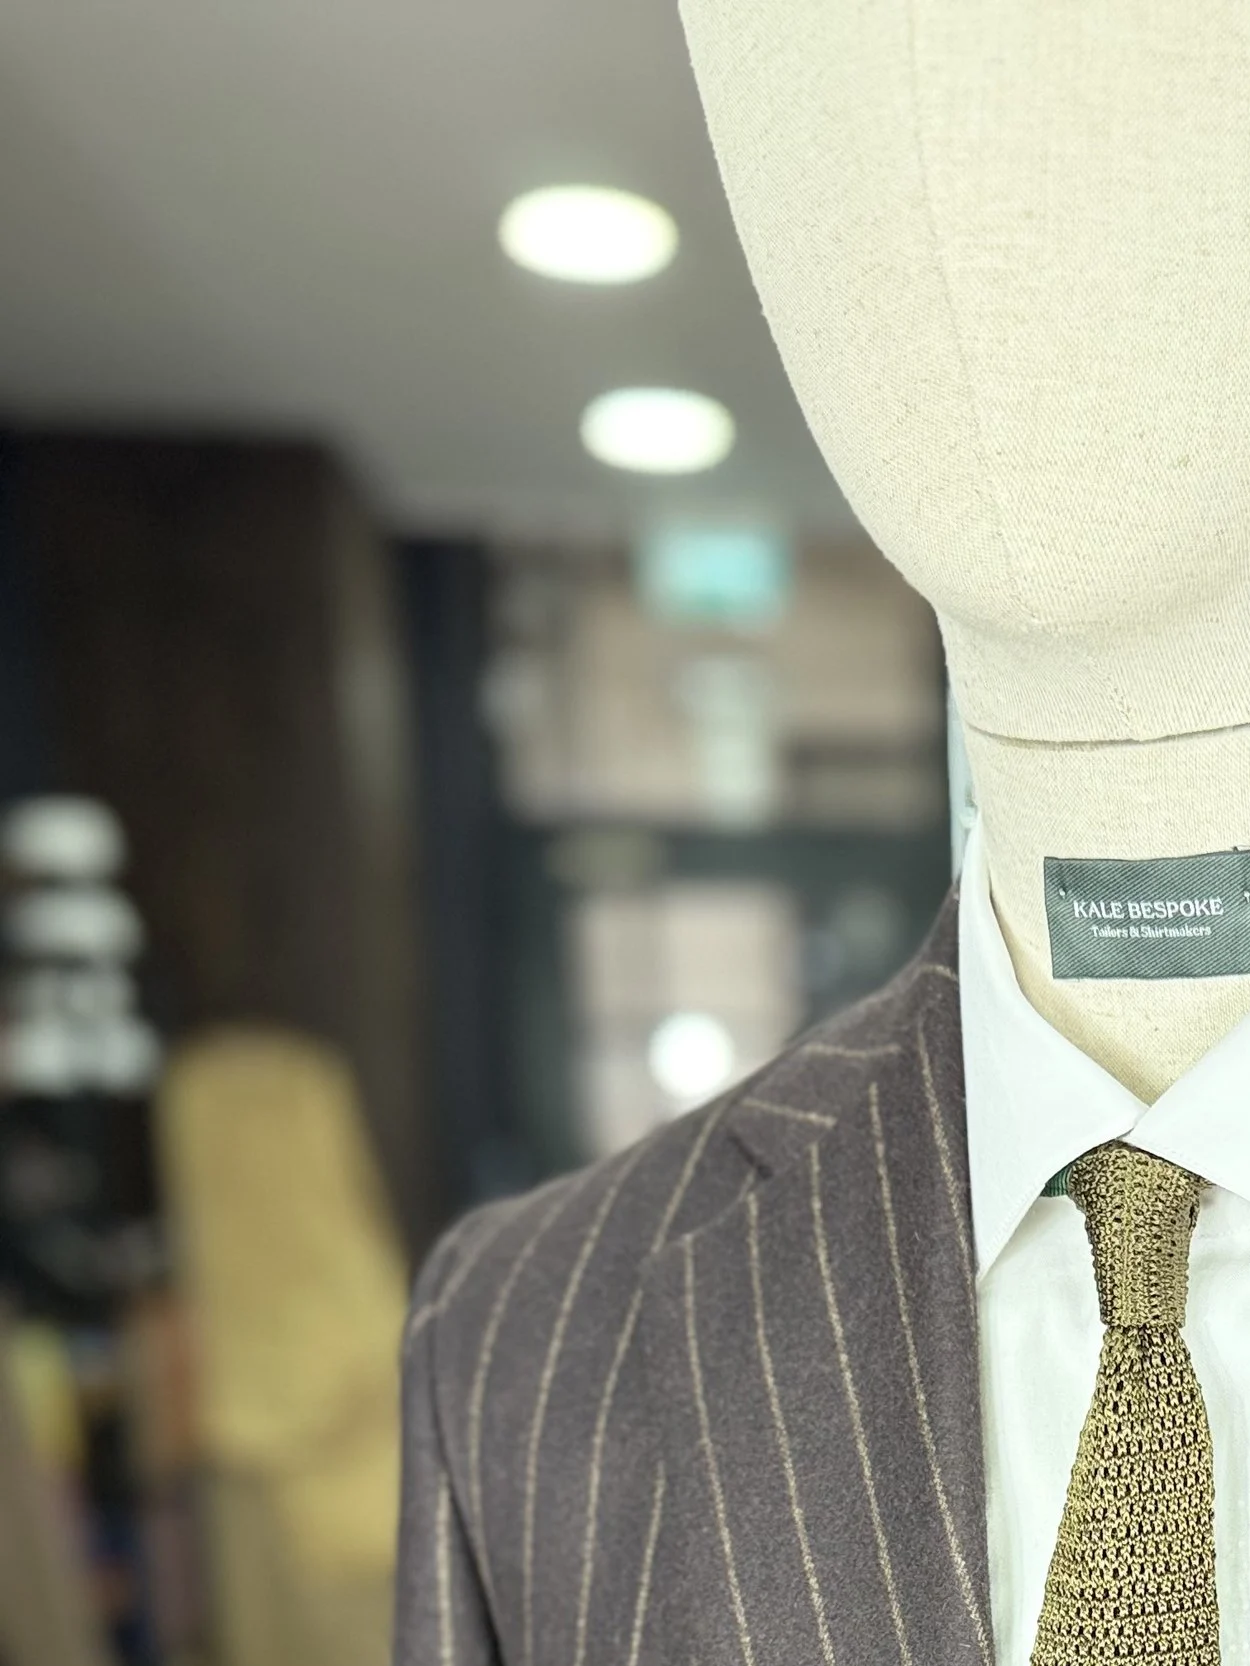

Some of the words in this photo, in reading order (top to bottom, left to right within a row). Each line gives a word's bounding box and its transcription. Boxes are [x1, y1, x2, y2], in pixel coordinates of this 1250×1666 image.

[1073, 900, 1125, 919] KALE
[1128, 897, 1224, 919] BESPOKE
[1091, 925, 1128, 938] Tailors
[1129, 924, 1141, 938] &
